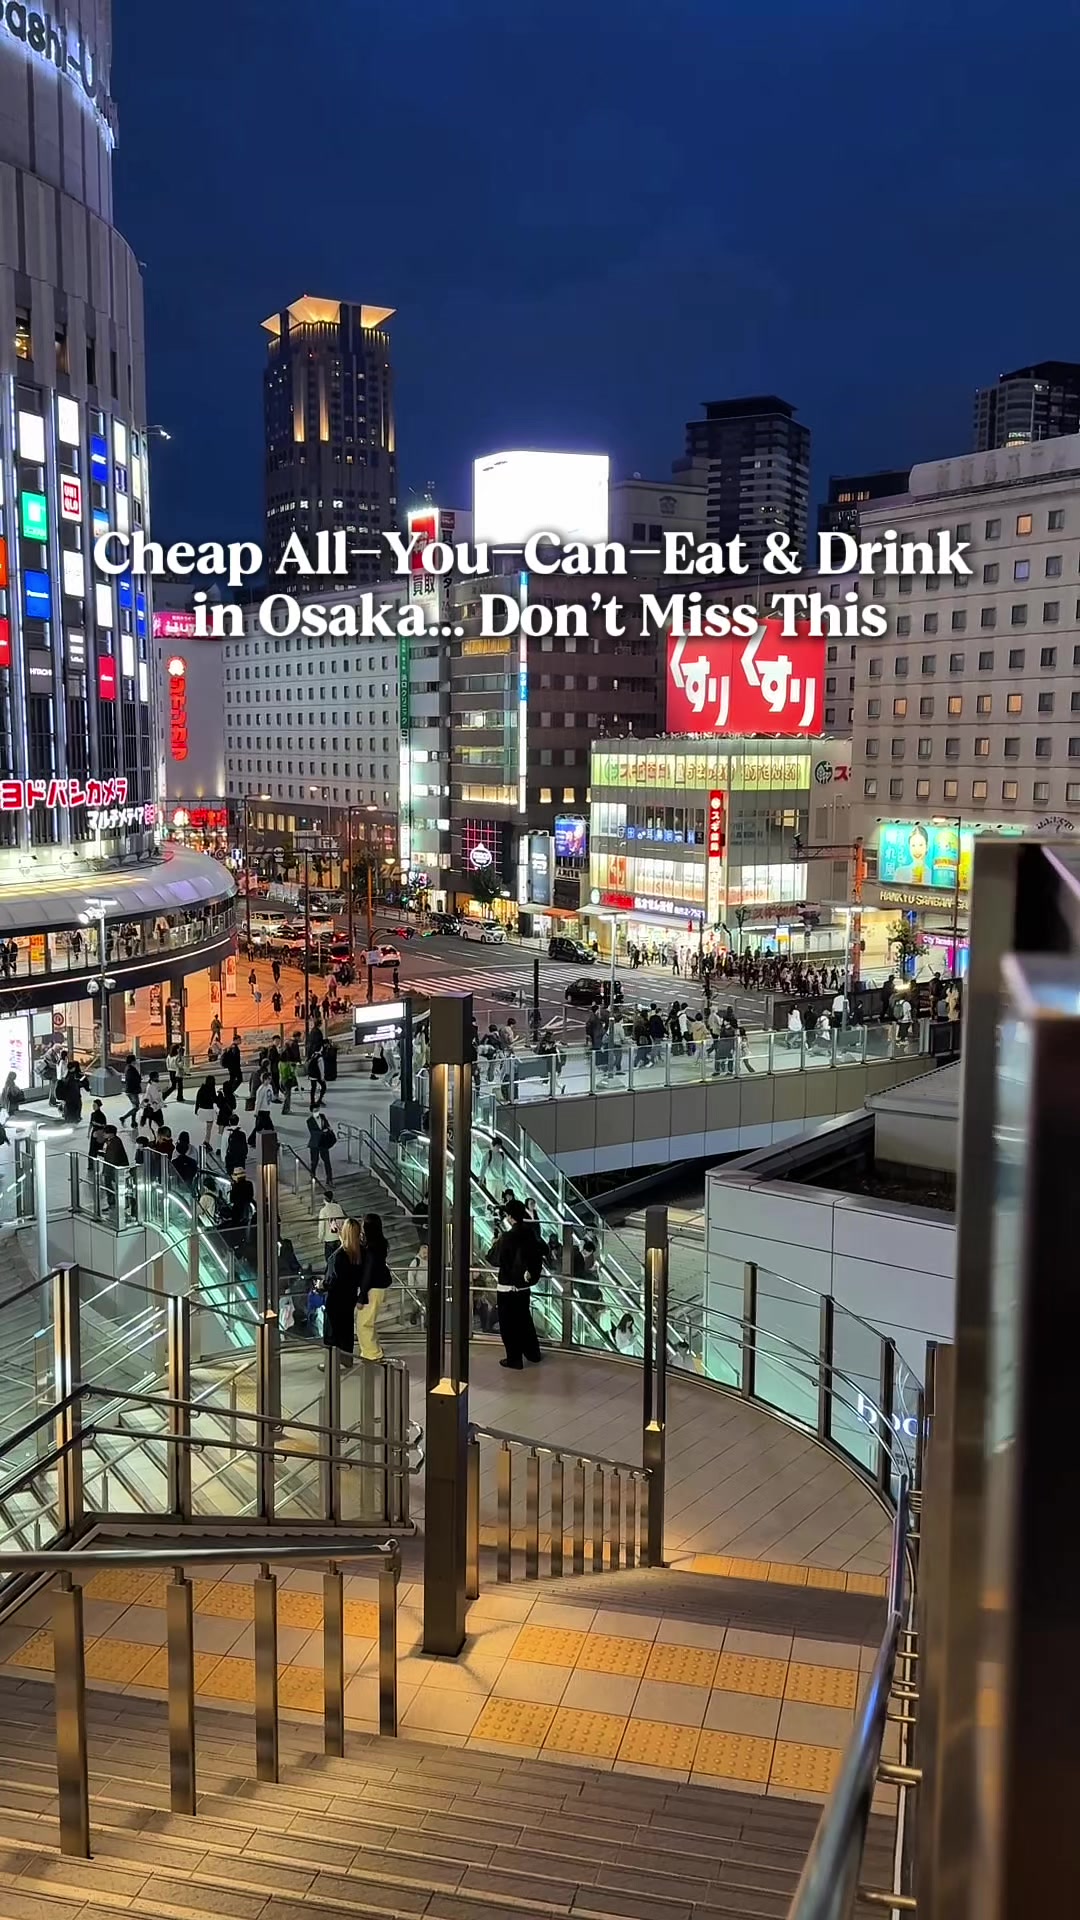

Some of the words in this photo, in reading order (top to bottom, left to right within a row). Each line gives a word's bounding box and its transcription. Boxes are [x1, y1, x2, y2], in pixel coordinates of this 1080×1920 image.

[669, 628, 730, 727] くすり
[740, 624, 816, 727] くすり
[1, 777, 128, 810] ヨドバシカメラ
